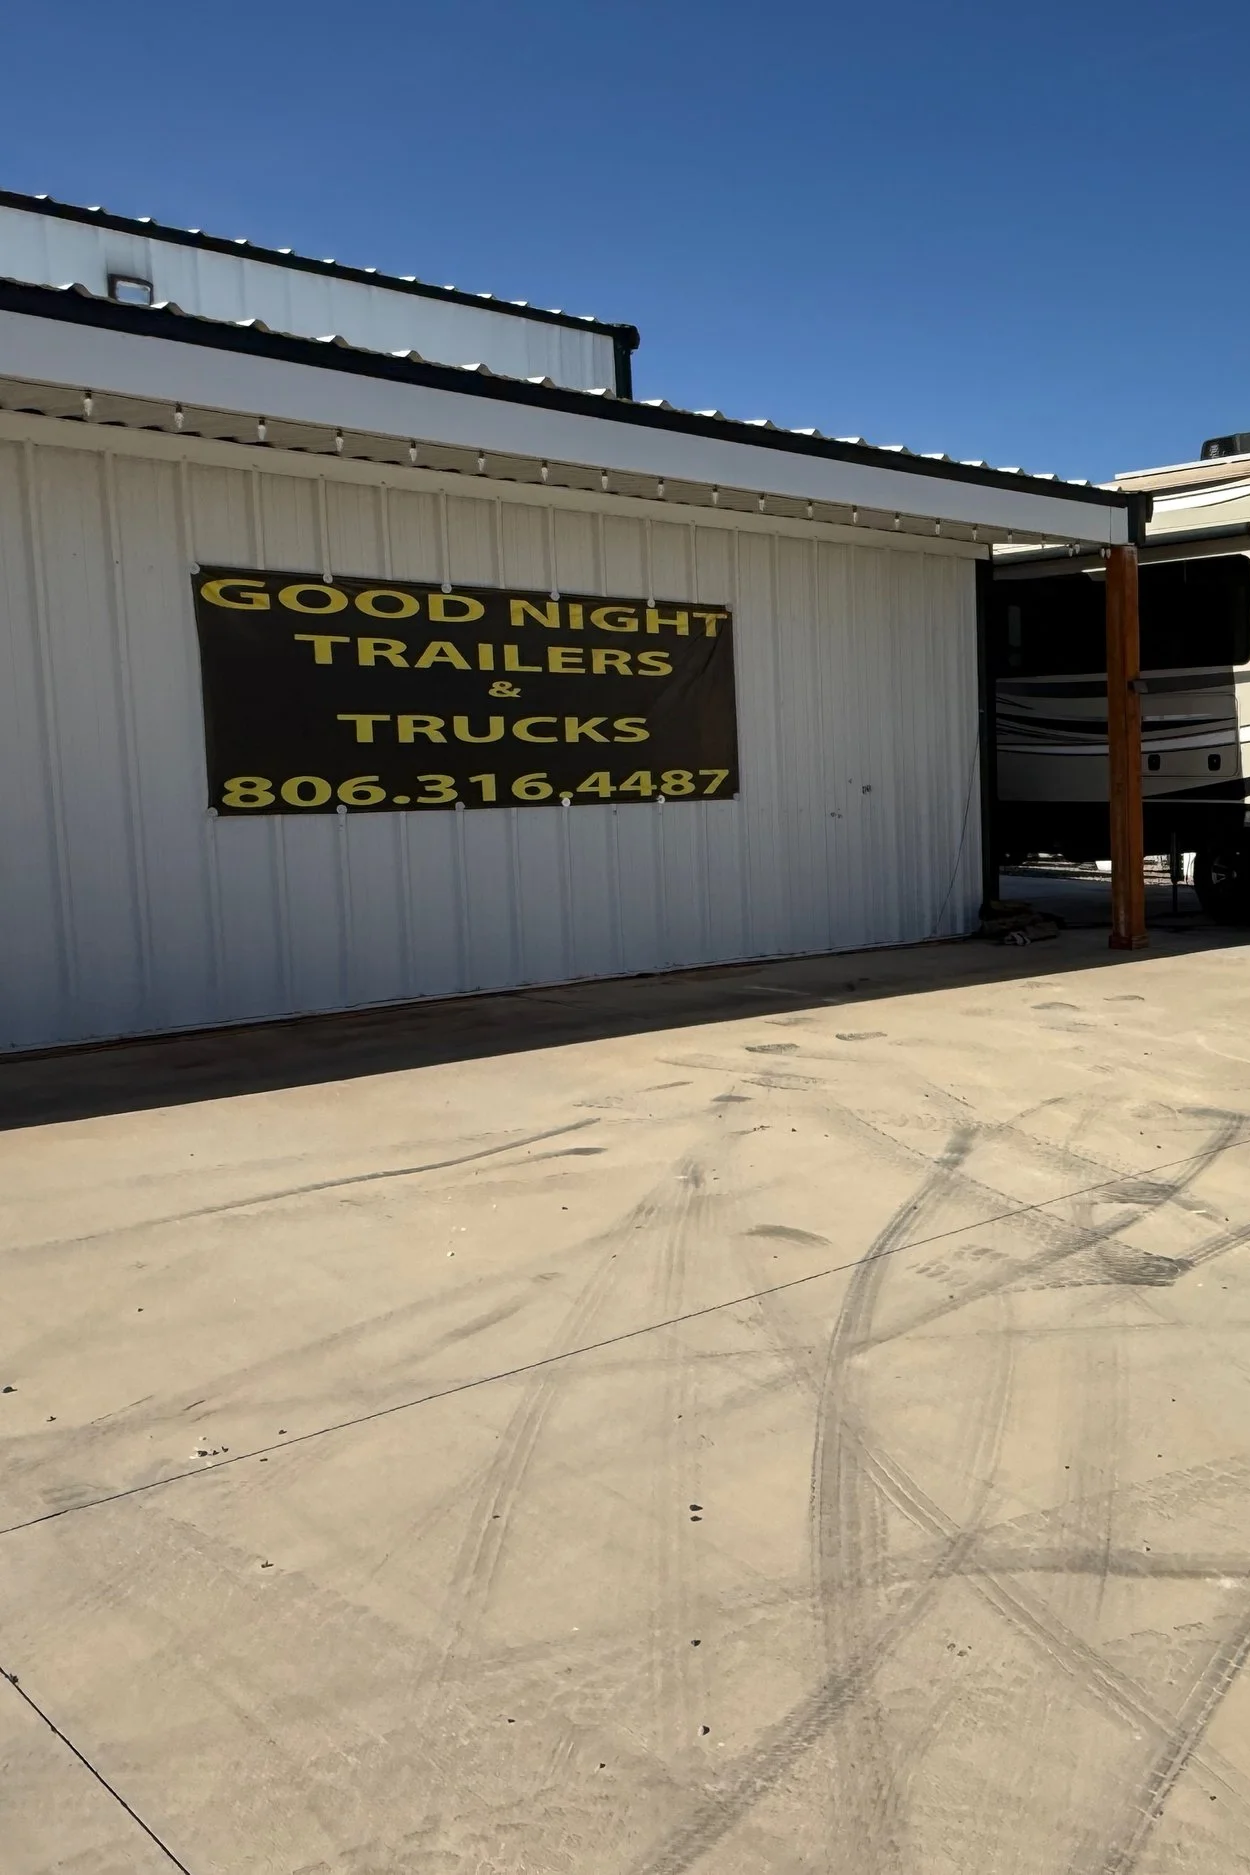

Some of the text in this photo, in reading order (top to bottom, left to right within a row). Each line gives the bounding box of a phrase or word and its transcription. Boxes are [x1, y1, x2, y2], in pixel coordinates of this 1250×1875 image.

[200, 578, 728, 637] GOOD NIGHT
[294, 634, 674, 677] TRAILERS
[488, 680, 522, 698] &
[336, 714, 650, 743] TRUCKS
[222, 769, 730, 808] 806.316.4487
